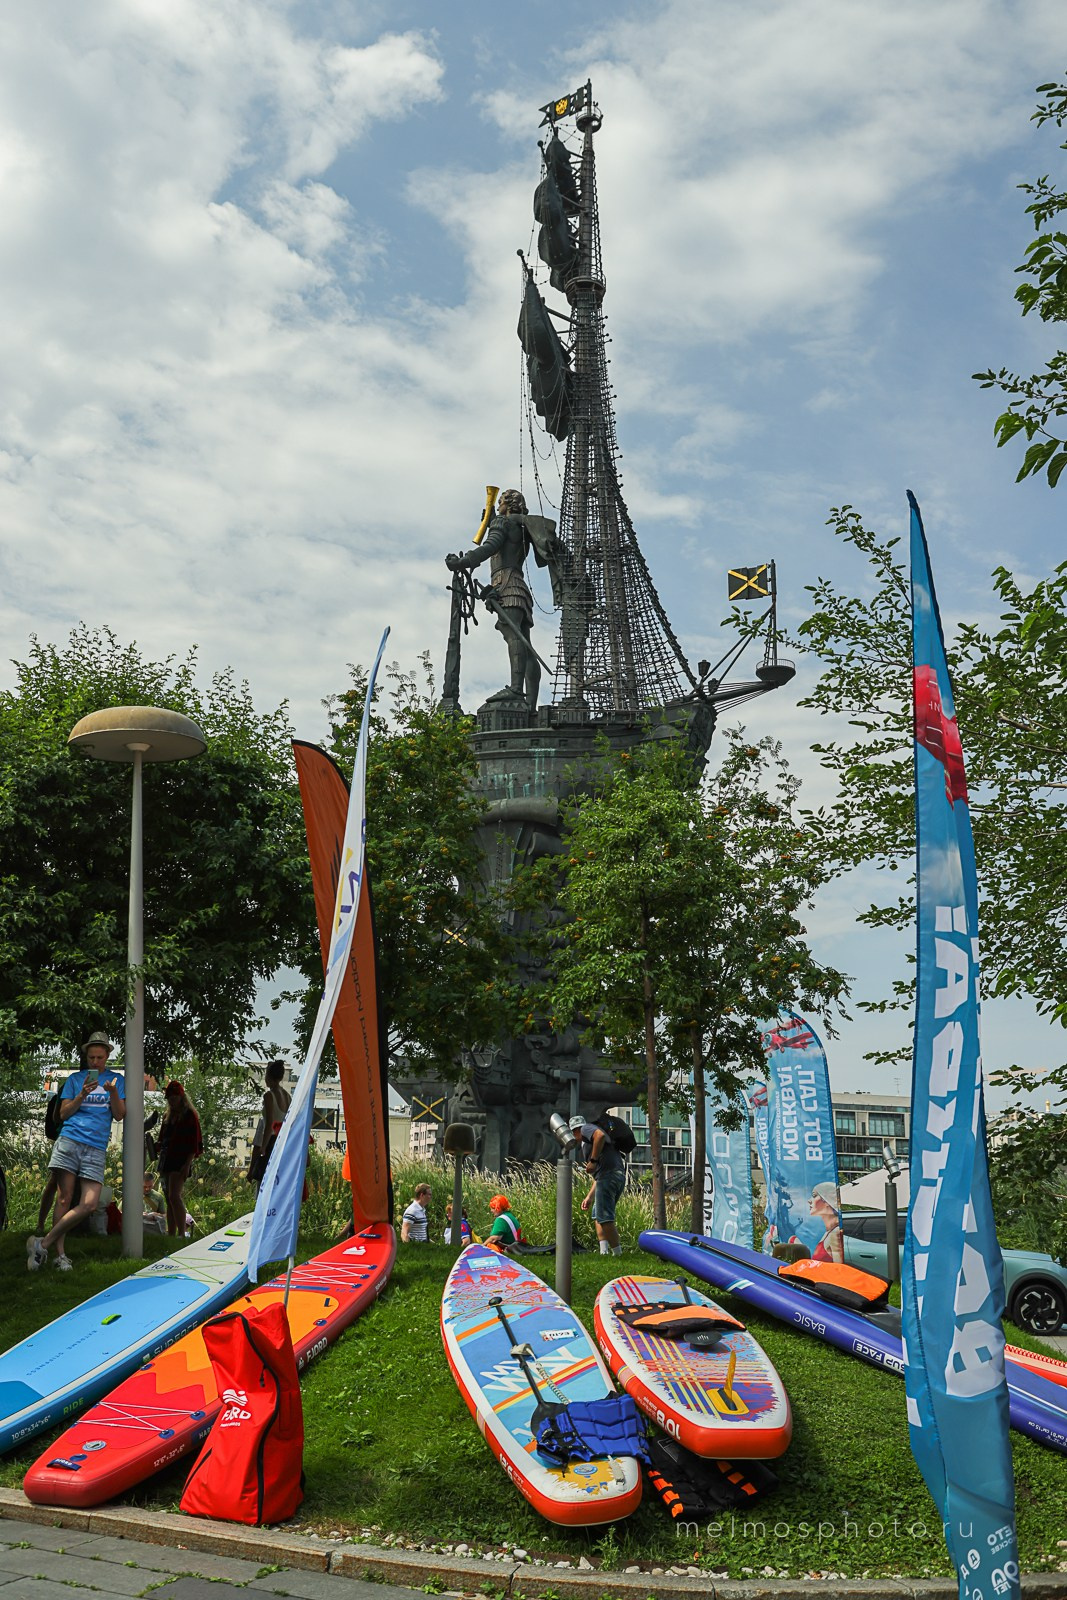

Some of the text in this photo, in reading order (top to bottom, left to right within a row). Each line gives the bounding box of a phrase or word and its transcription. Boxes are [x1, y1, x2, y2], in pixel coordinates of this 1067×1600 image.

[793, 1311, 826, 1335] BASIC
[306, 1337, 328, 1363] FJORD
[856, 1342, 883, 1363] FACE
[63, 1396, 85, 1416] RIDE
